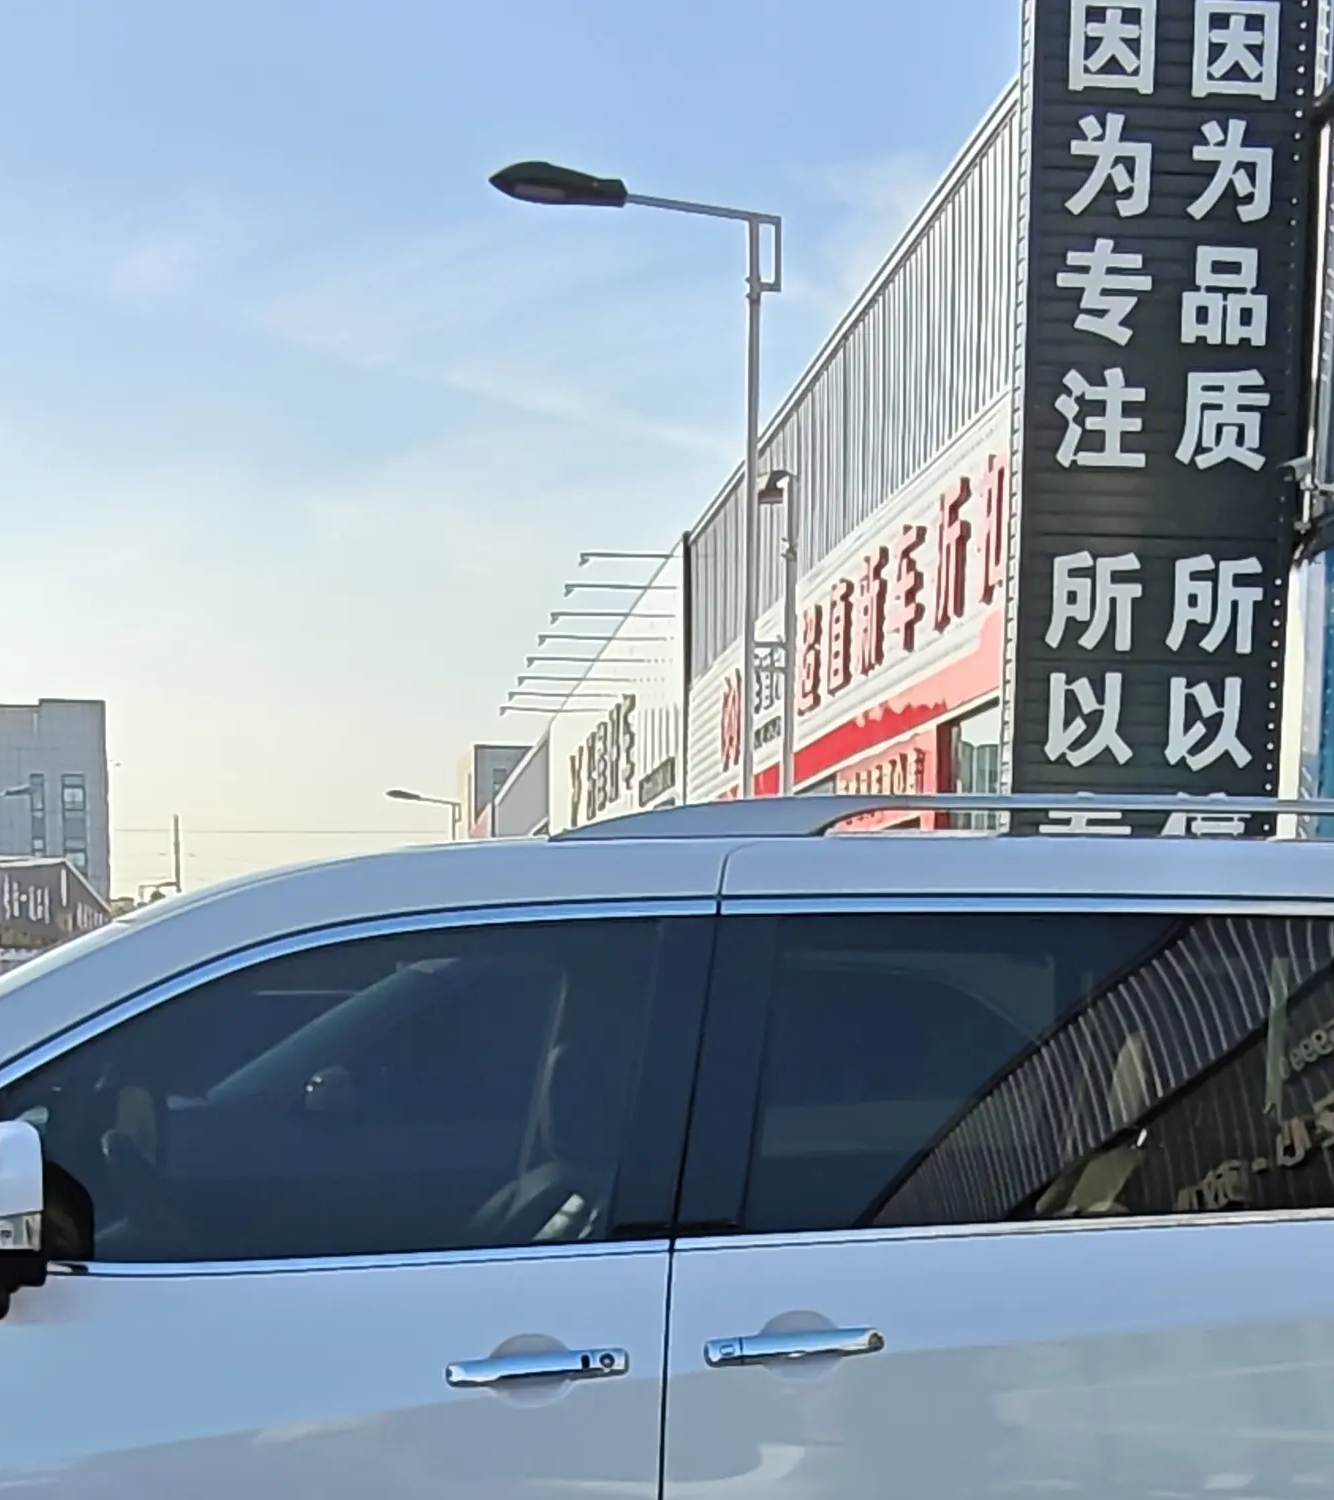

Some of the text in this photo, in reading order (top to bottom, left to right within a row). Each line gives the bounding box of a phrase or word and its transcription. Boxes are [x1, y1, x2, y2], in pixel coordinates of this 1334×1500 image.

[1056, 0, 1156, 471] 因为专注
[1175, 0, 1280, 473] 因为品质
